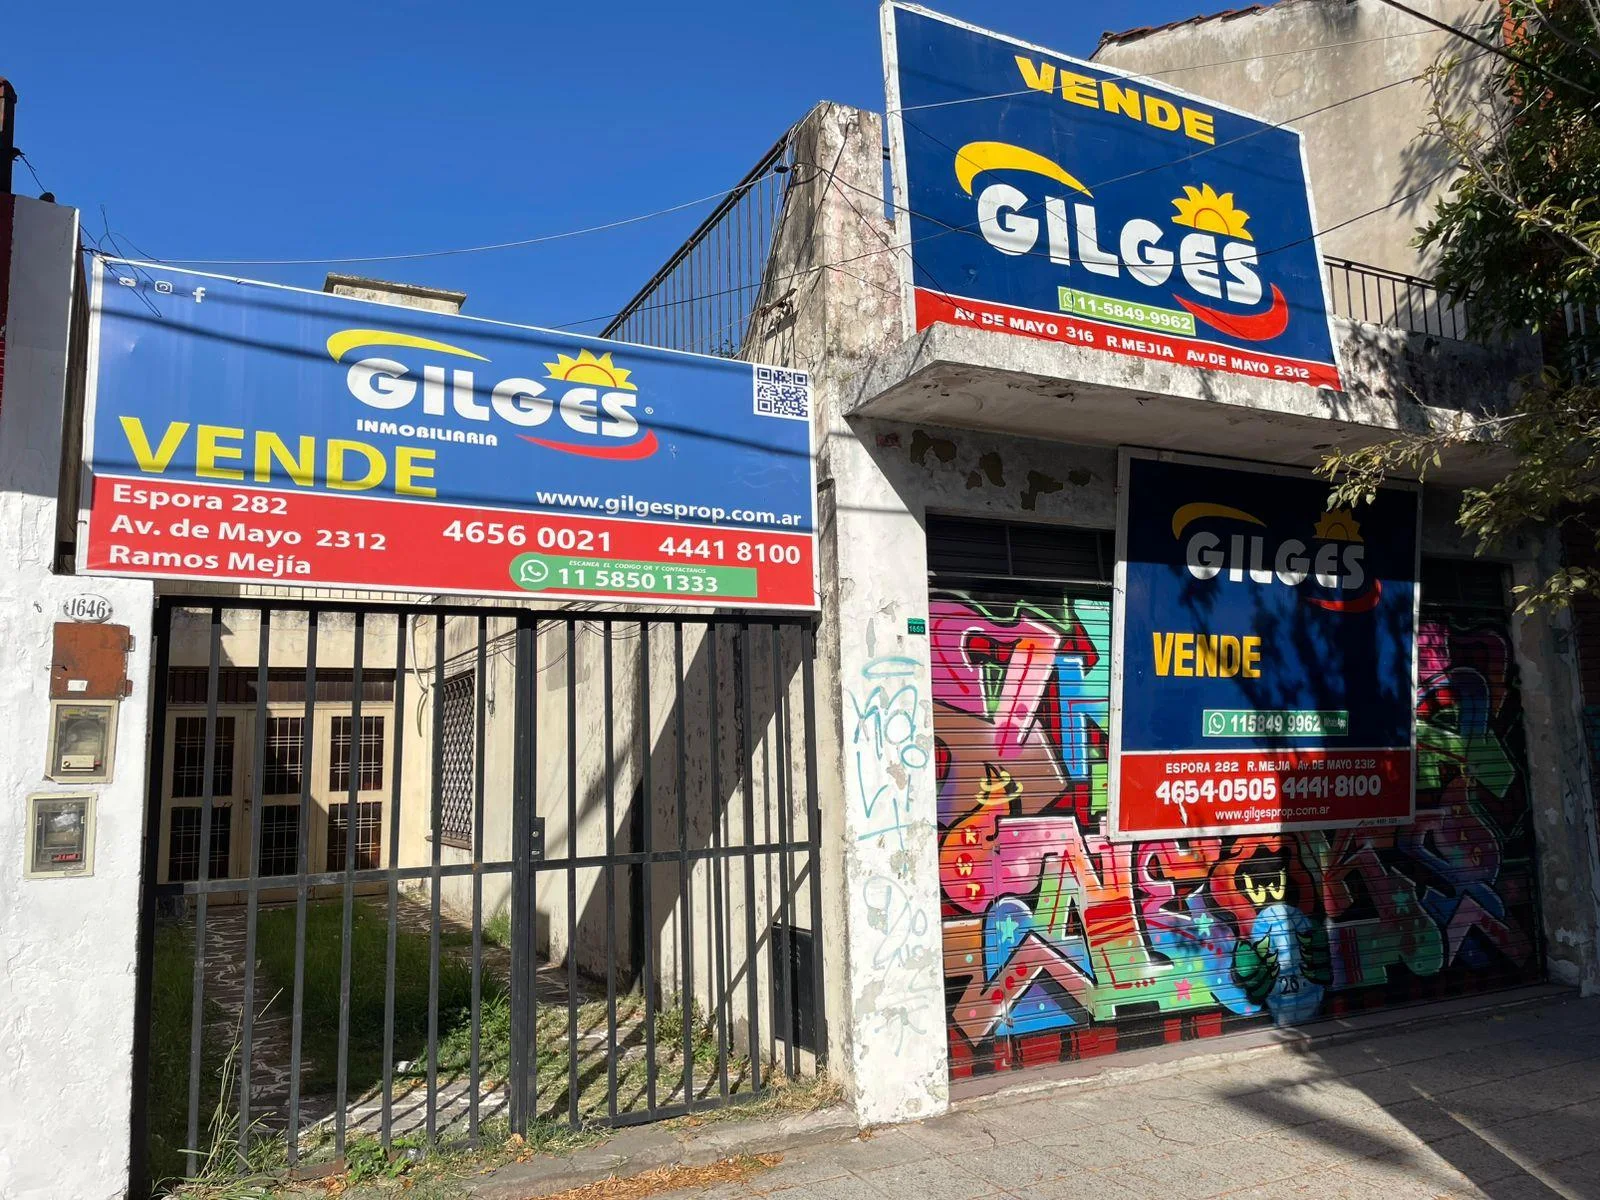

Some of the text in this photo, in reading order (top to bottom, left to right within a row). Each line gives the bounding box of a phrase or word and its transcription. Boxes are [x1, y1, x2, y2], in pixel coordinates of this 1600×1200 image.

[1014, 55, 1216, 146] VENDE
[977, 183, 1263, 305] GILGES
[1077, 295, 1192, 331] 11-5849-9962
[981, 311, 1005, 327] DE
[1009, 316, 1059, 335] MAYO
[1065, 327, 1095, 342] 316
[1231, 356, 1270, 374] MAYO
[1274, 365, 1310, 379] 2312
[346, 357, 639, 438] GILGES
[356, 418, 498, 447] INMOBILIARIA
[119, 415, 437, 498] VENDE
[112, 483, 288, 515] Espora 282
[536, 490, 802, 527] www.gilgesprop.com.ar
[110, 514, 387, 551] Av. de Mayo 2312
[442, 519, 611, 552] 4656 0021
[108, 544, 312, 577] Ramos Mejía
[658, 536, 801, 565] 4441 8100
[1186, 530, 1365, 590] GILGES
[558, 568, 719, 594] 11 5850 1333
[70, 597, 106, 618] 1646
[1152, 631, 1262, 678] VENDE
[1230, 713, 1283, 733] 115849
[1287, 713, 1322, 733] 9962
[1165, 762, 1211, 774] ESPORA
[1214, 761, 1239, 773] 282
[1327, 759, 1353, 771] MAYO
[1355, 759, 1376, 770] 2312
[1155, 774, 1382, 806] 4654-0505 4441-8100
[1215, 805, 1330, 822] www.gilgesprop.com.ar
